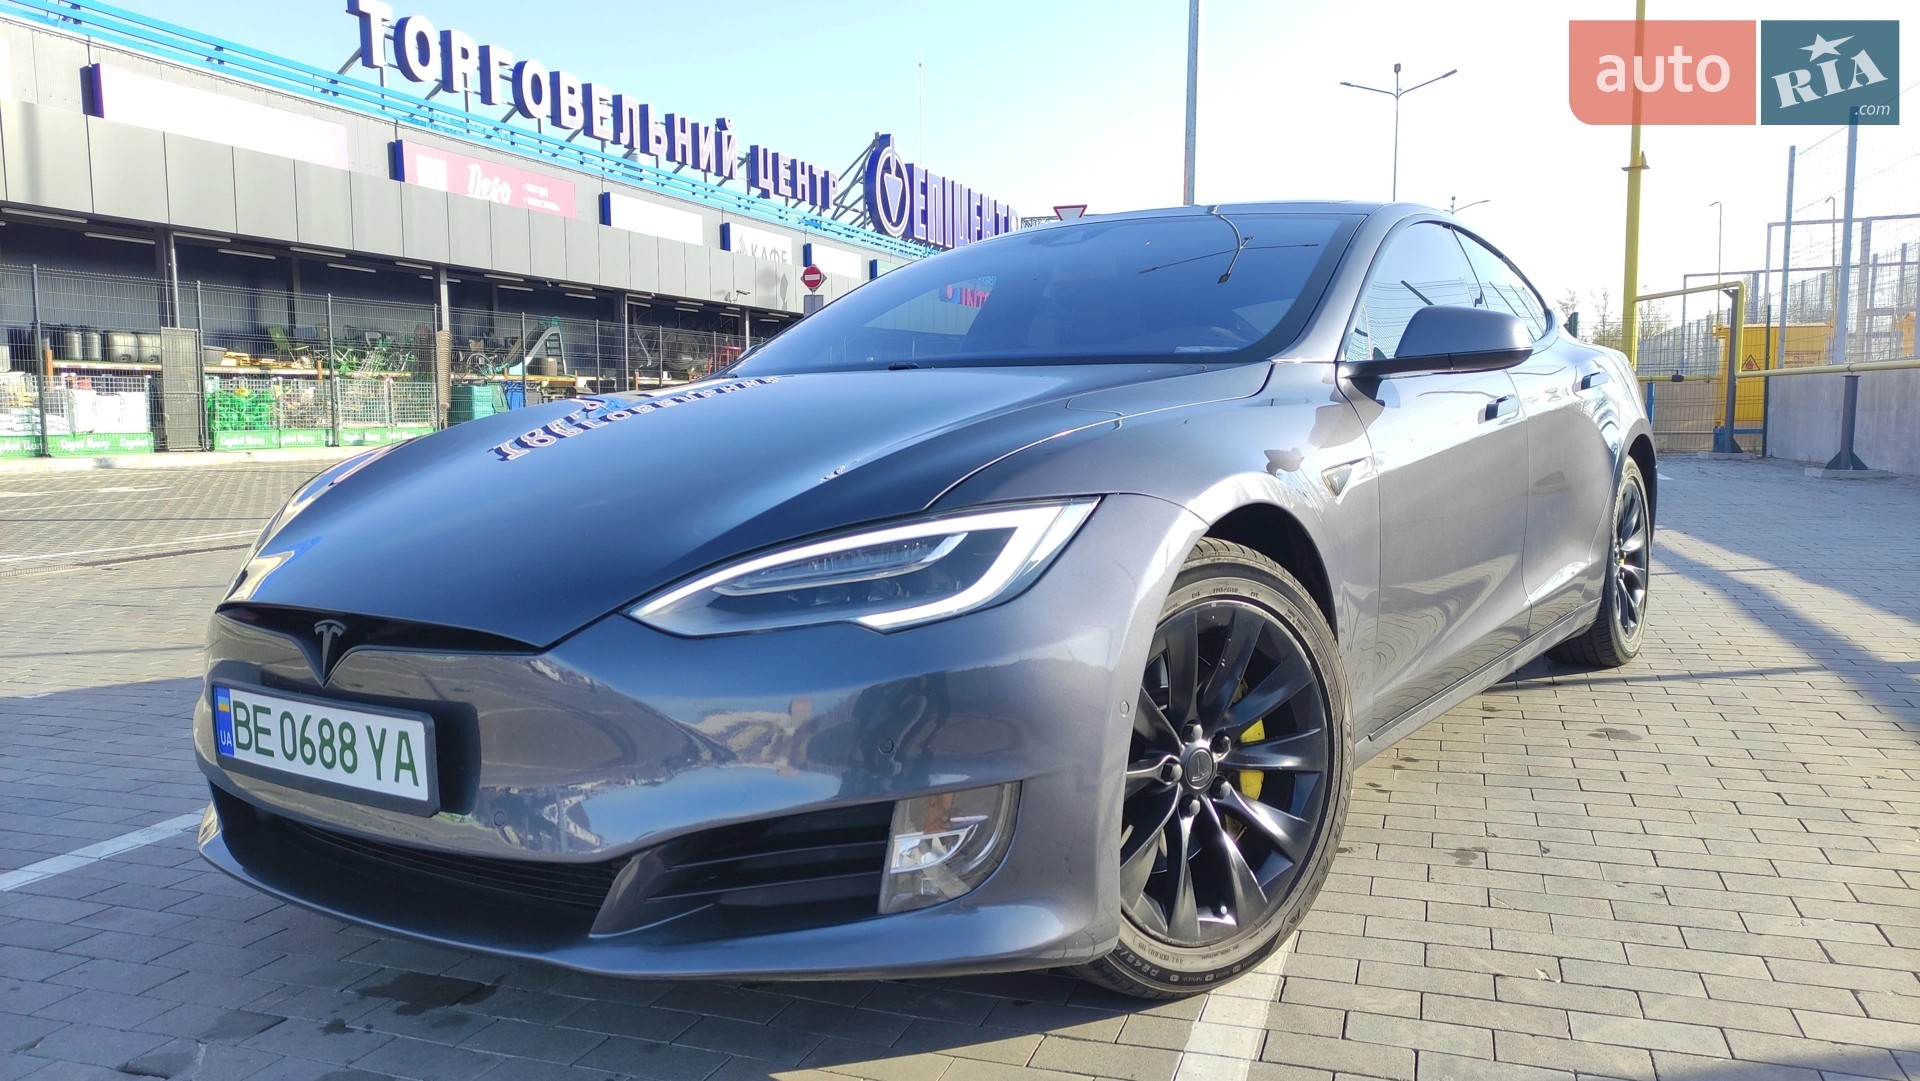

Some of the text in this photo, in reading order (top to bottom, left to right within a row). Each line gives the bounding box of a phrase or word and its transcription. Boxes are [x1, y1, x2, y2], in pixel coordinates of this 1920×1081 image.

[346, 0, 839, 209] ТОРГОВЕЛЬНИЙ ЦЕНТР
[219, 729, 233, 748] UA
[232, 700, 419, 787] BE 0688 YA
